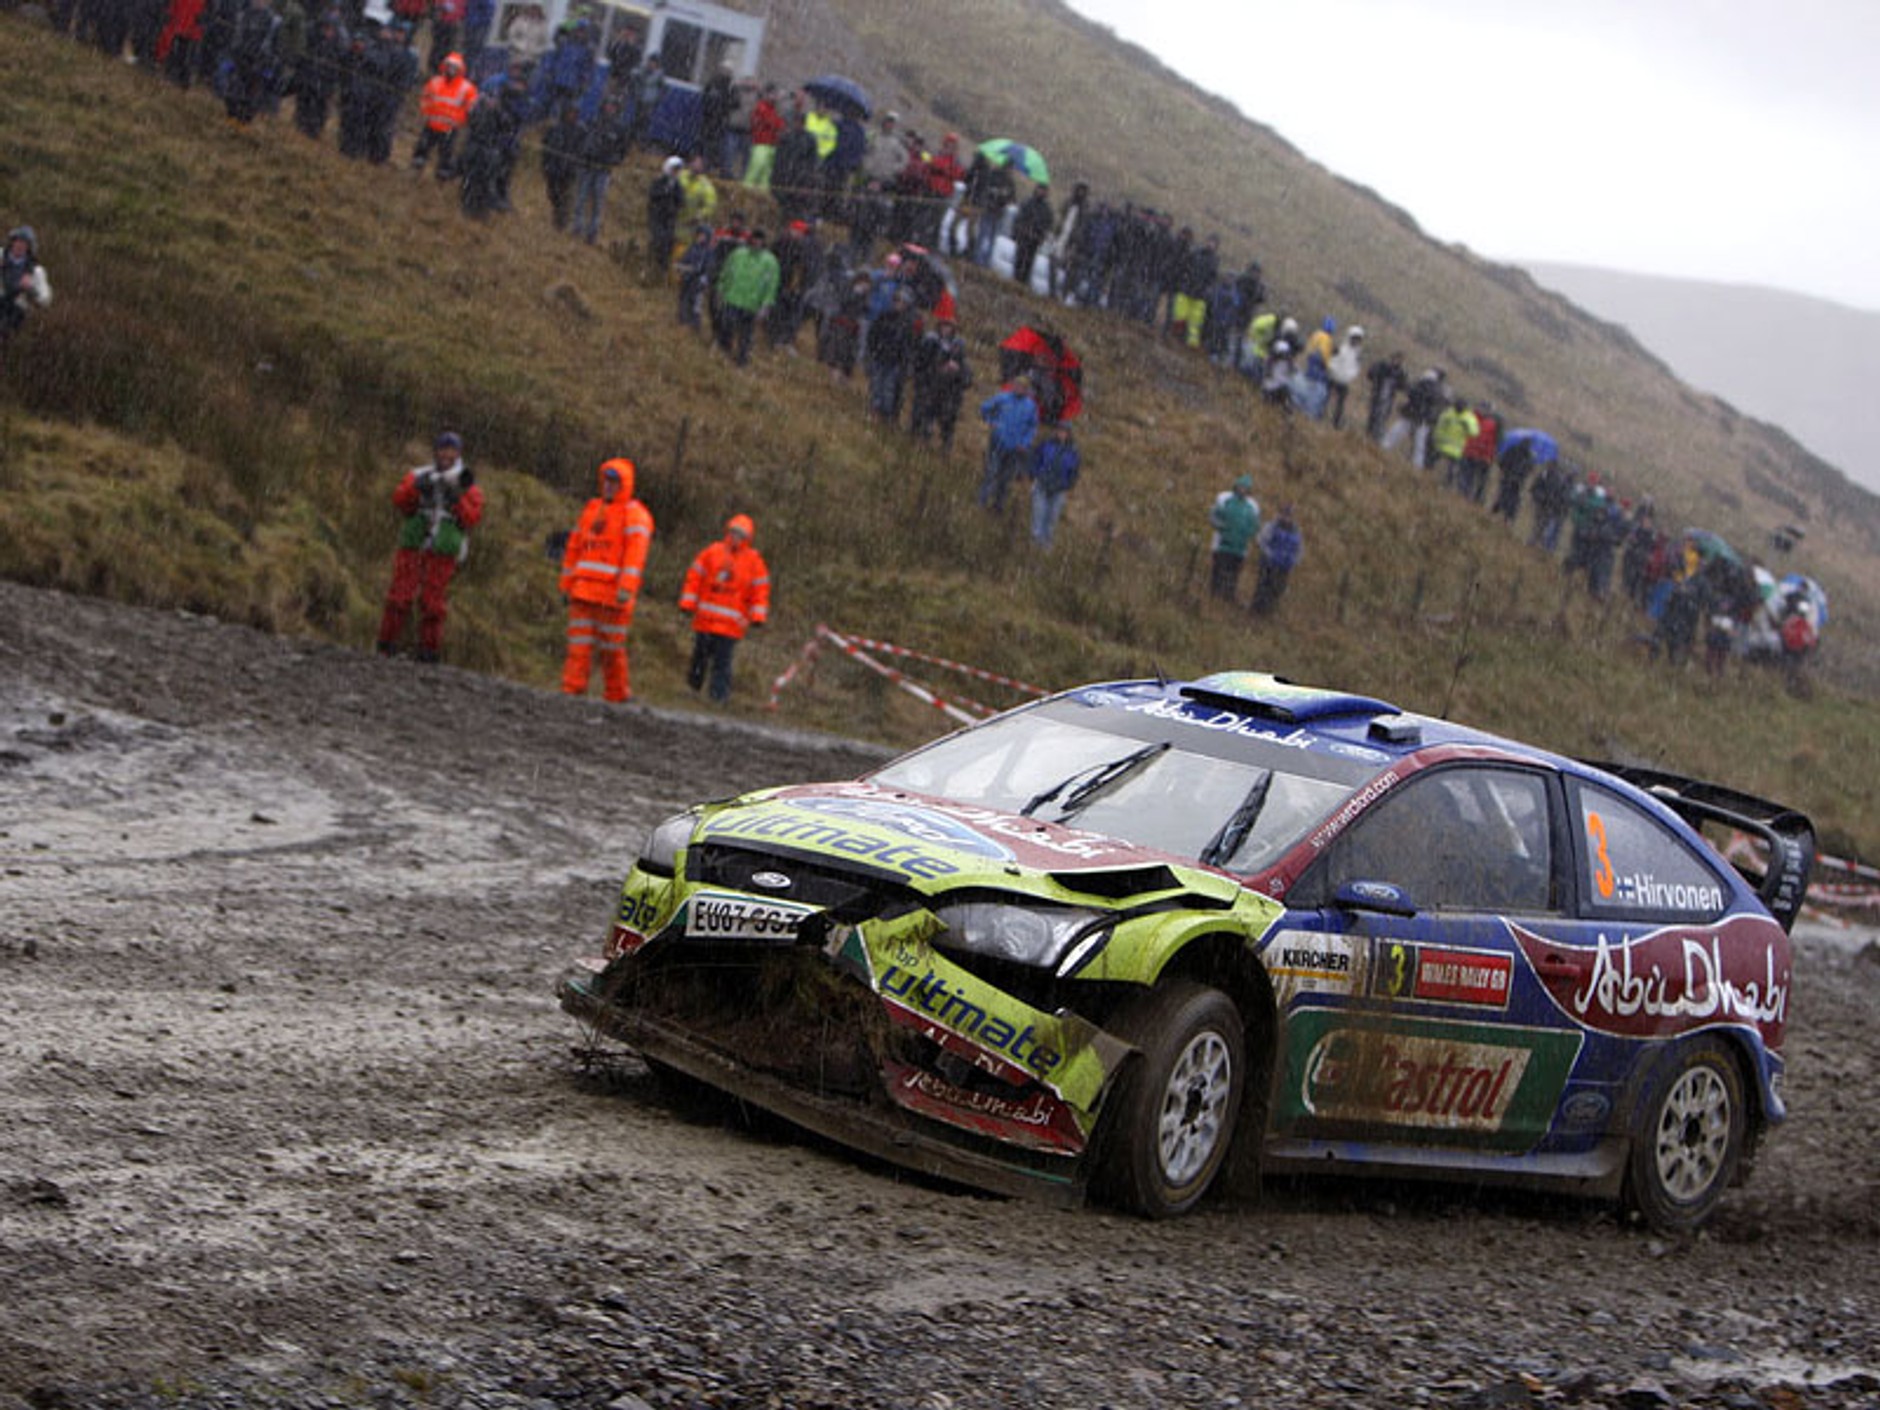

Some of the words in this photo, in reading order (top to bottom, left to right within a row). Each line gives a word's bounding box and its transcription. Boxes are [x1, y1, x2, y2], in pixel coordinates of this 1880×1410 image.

[705, 813, 960, 880] ultimate
[1588, 811, 1614, 899] 3
[695, 902, 747, 932] EU07
[1634, 870, 1725, 912] Hirvonen
[1388, 943, 1406, 996] 3
[1575, 932, 1680, 1017] Abu
[1676, 935, 1789, 1023] Dhabi
[880, 964, 1063, 1075] ultimate
